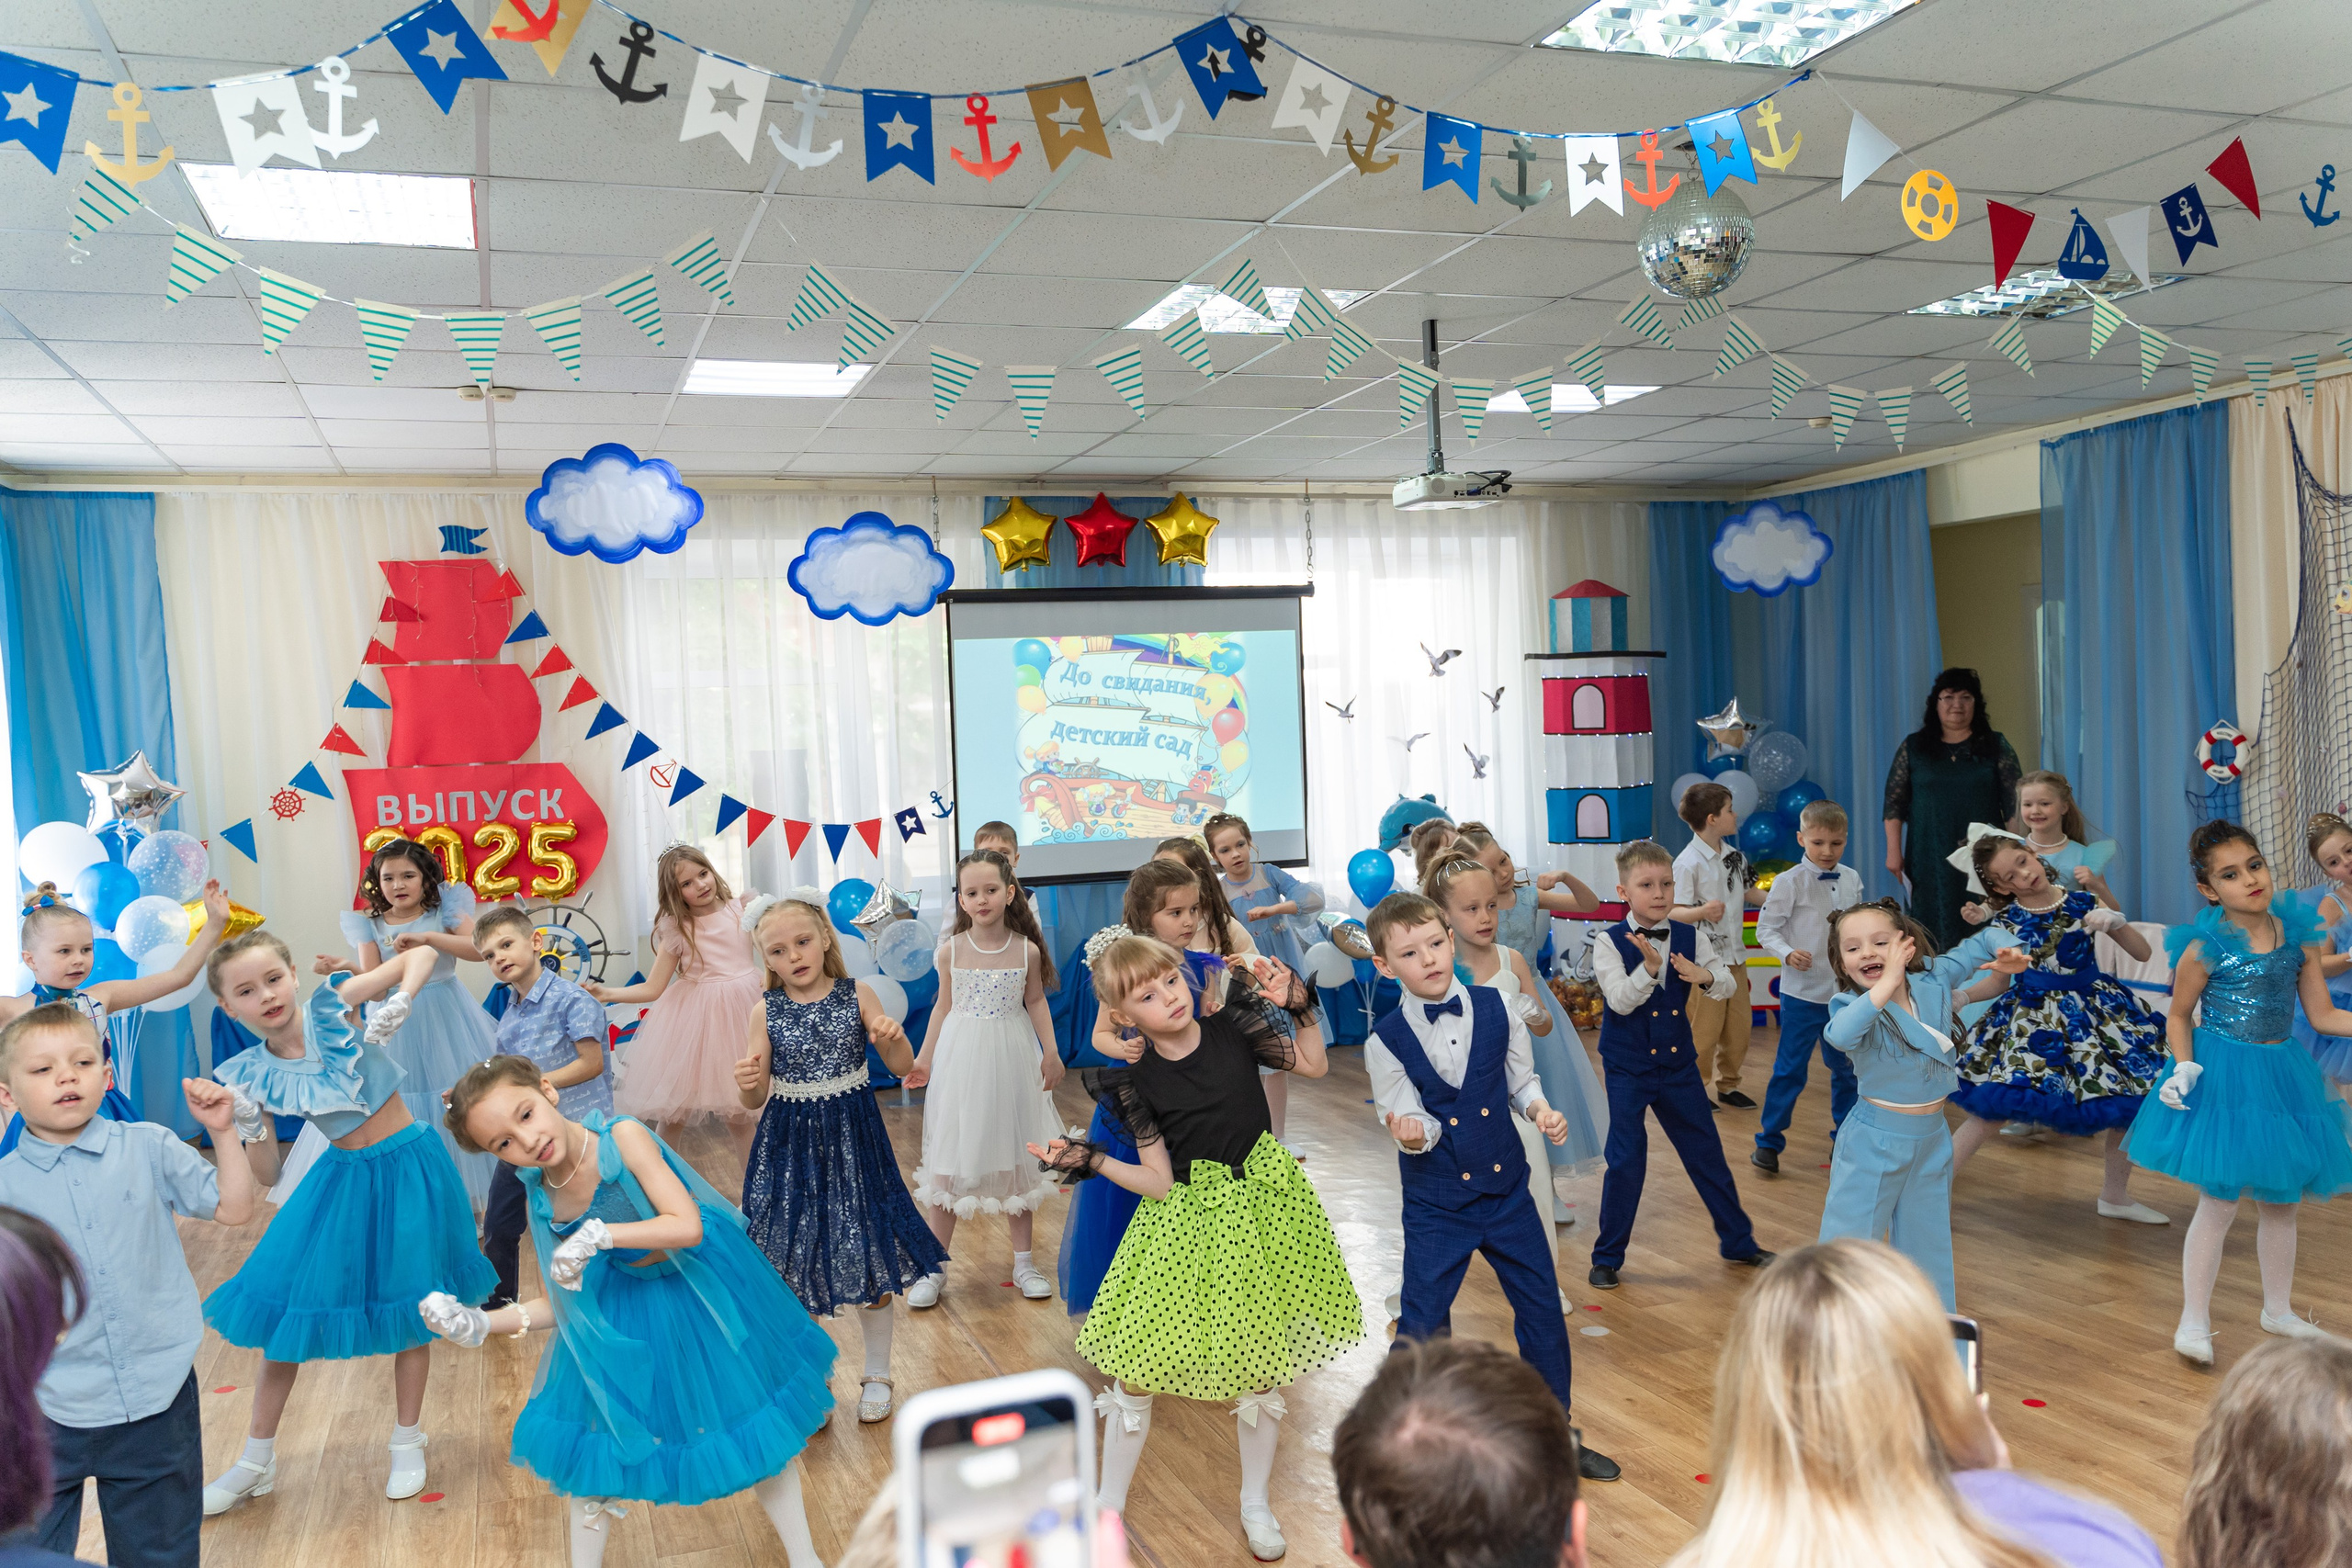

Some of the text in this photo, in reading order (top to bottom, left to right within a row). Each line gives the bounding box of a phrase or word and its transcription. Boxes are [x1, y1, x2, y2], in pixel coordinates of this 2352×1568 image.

[1059, 660, 1212, 706] До свидания,
[1050, 720, 1193, 761] детский сад
[377, 788, 565, 827] ВЫПУСК
